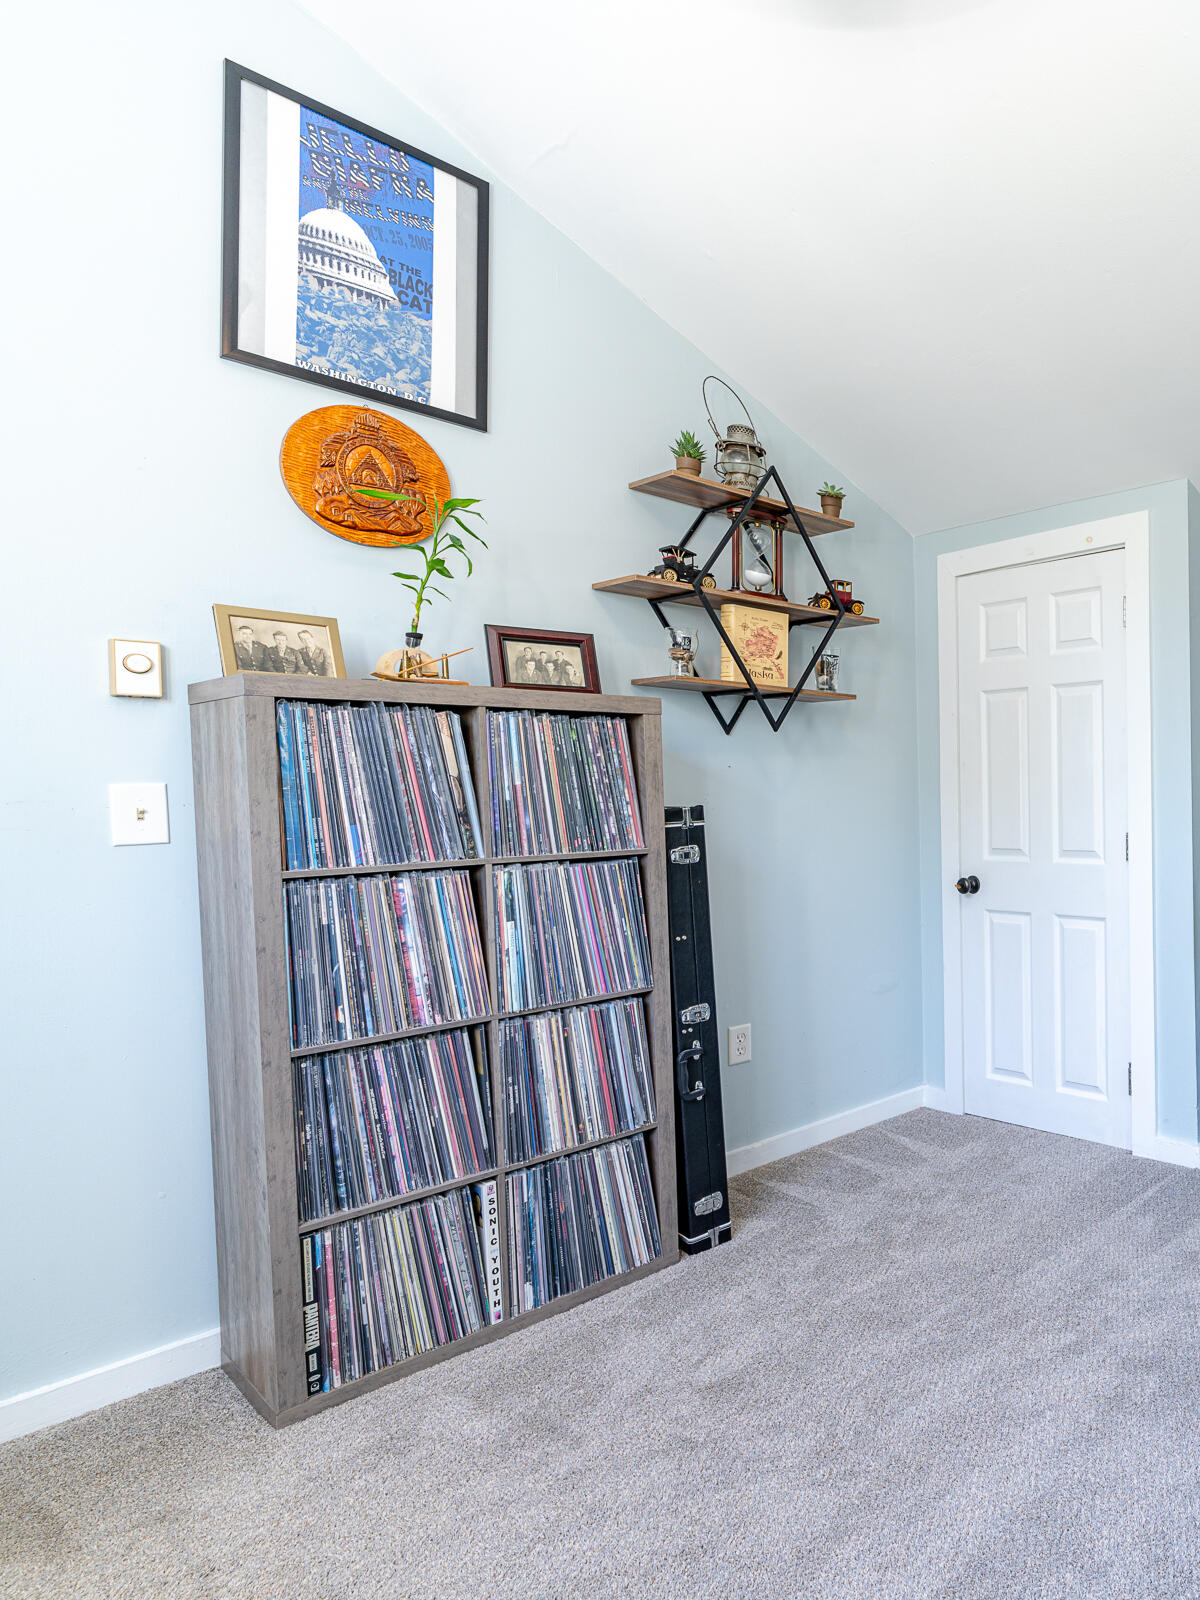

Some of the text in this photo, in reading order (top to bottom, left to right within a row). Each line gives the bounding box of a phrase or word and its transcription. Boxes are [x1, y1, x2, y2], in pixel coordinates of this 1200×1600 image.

[308, 149, 434, 203] BIAFRA
[343, 198, 434, 232] MELVINS
[380, 255, 422, 278] AT THE
[389, 268, 434, 300] BLACK
[397, 290, 433, 314] CAT
[747, 667, 774, 680] laska
[488, 1197, 501, 1308] SONIC YOUTH
[303, 1302, 321, 1352] PANTERA
